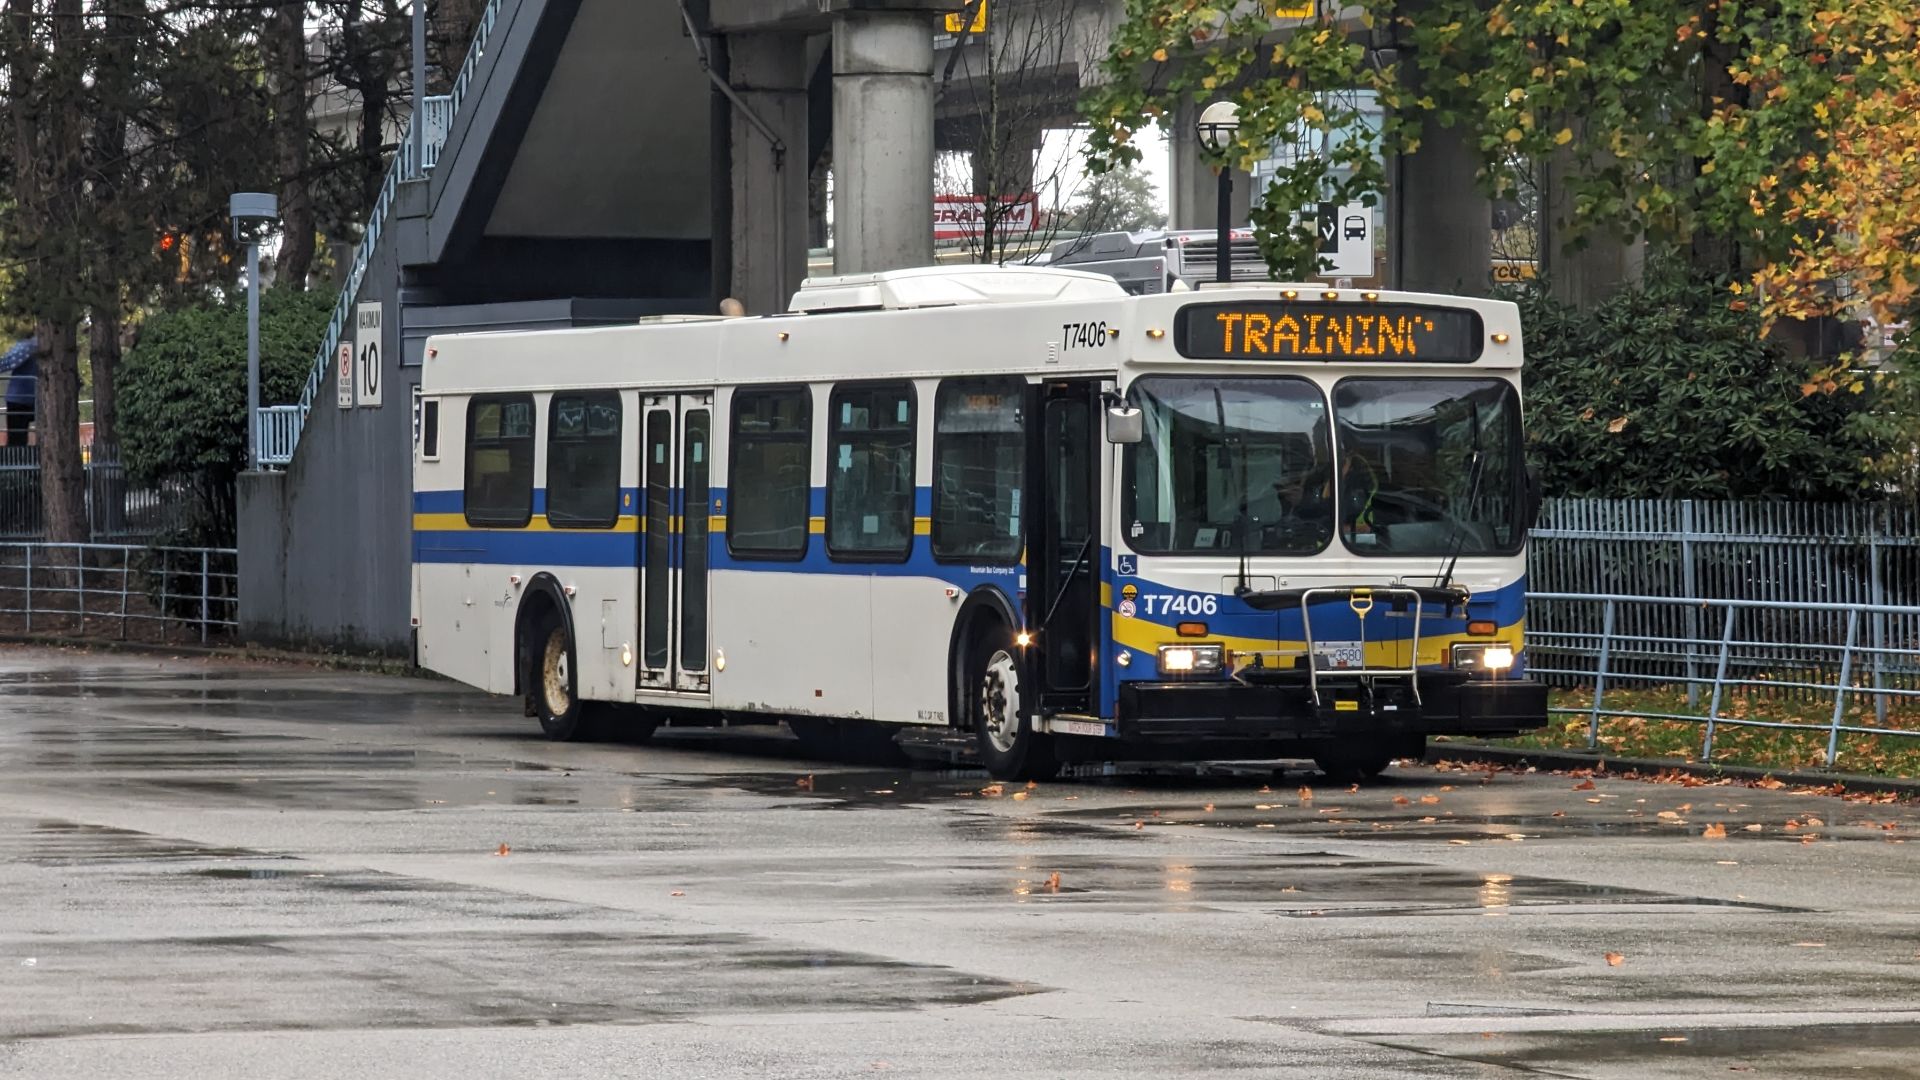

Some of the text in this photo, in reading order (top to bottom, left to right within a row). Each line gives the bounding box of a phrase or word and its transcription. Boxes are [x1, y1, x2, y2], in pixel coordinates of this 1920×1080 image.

[358, 311, 381, 329] MAXIMUM
[1063, 321, 1107, 351] T7406
[360, 341, 379, 396] 10
[970, 566, 986, 574] Mountain
[993, 566, 1008, 576] Company
[1143, 594, 1218, 616] T7406
